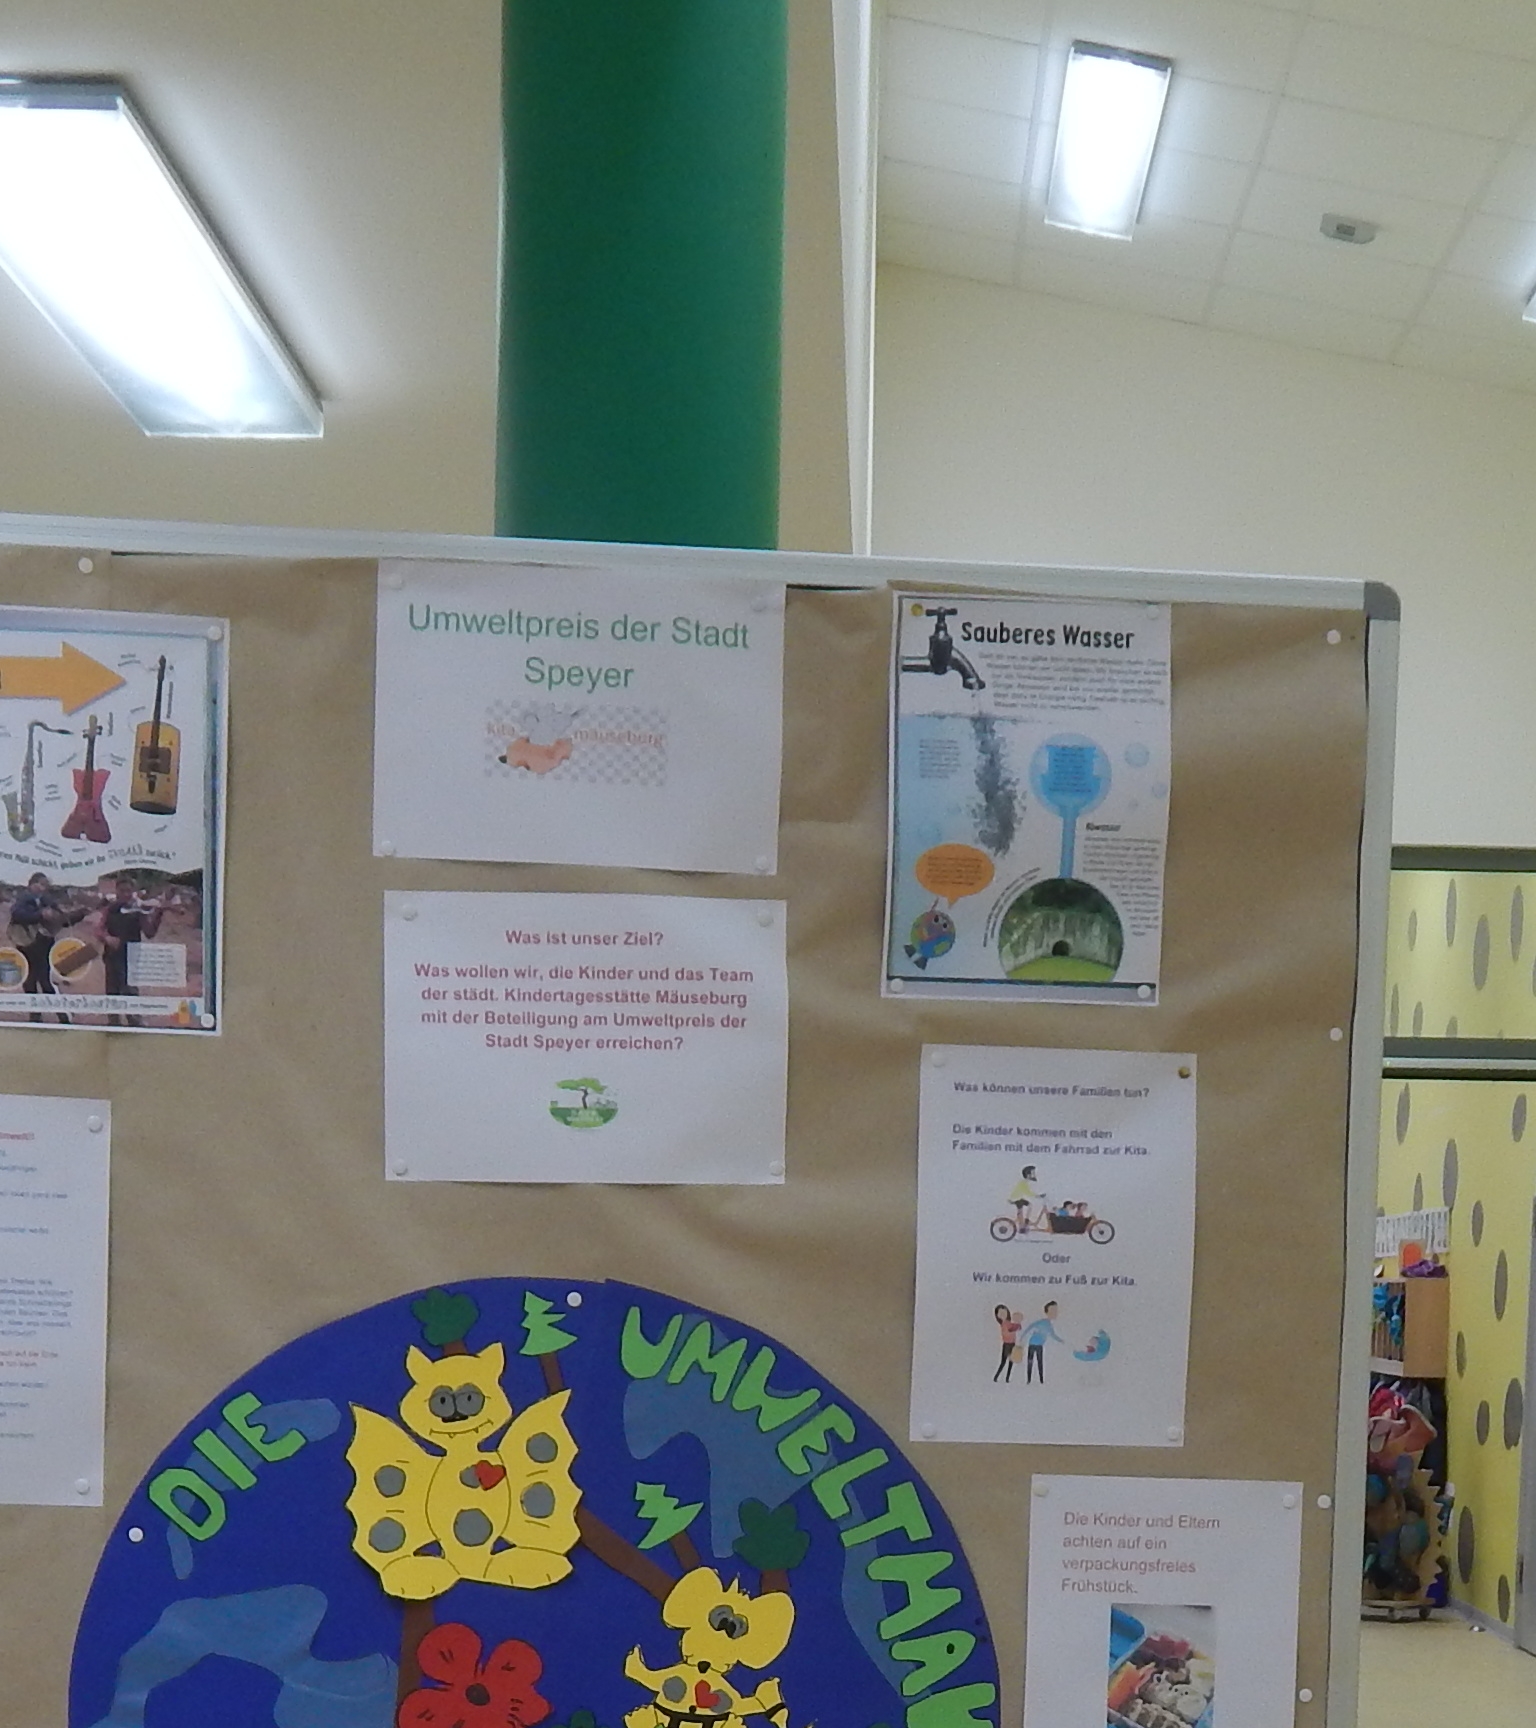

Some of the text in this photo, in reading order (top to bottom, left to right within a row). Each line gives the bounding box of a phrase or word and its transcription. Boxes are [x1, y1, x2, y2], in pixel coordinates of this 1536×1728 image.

[408, 603, 749, 649] Umweltpreis der Stadt
[961, 621, 1135, 649] Sauberes Wasser
[524, 656, 635, 693] Speyer
[506, 930, 664, 947] Was ist unser Ziel?
[414, 963, 754, 984] Was wollen wir, die Kinder und das Team
[421, 986, 449, 1002] der
[504, 988, 651, 1006] Kindertagesstätte
[656, 989, 749, 1009] Mäuseburg
[421, 1010, 747, 1030] mit der Beteiligung am Umweltpreis der
[485, 1033, 684, 1052] Stadt Speyer erreichen?
[954, 1081, 979, 1093] Was
[982, 1082, 1026, 1095] können
[975, 1125, 1013, 1136] Kinder
[1016, 1126, 1066, 1138] kommen
[1070, 1129, 1088, 1139] mit
[952, 1140, 1002, 1152] Familien
[1005, 1142, 1023, 1153] mit
[1042, 1253, 1071, 1264] Oder
[972, 1272, 992, 1283] Wir
[995, 1272, 1045, 1284] kommen
[1048, 1276, 1062, 1285] zu
[148, 1391, 307, 1541] DIE
[1065, 1512, 1221, 1529] Die Kinder und Eltern
[1062, 1535, 1167, 1549] achten auf ein
[1062, 1556, 1196, 1575] verpackungsfreies
[1061, 1578, 1138, 1594] Frühstück.
